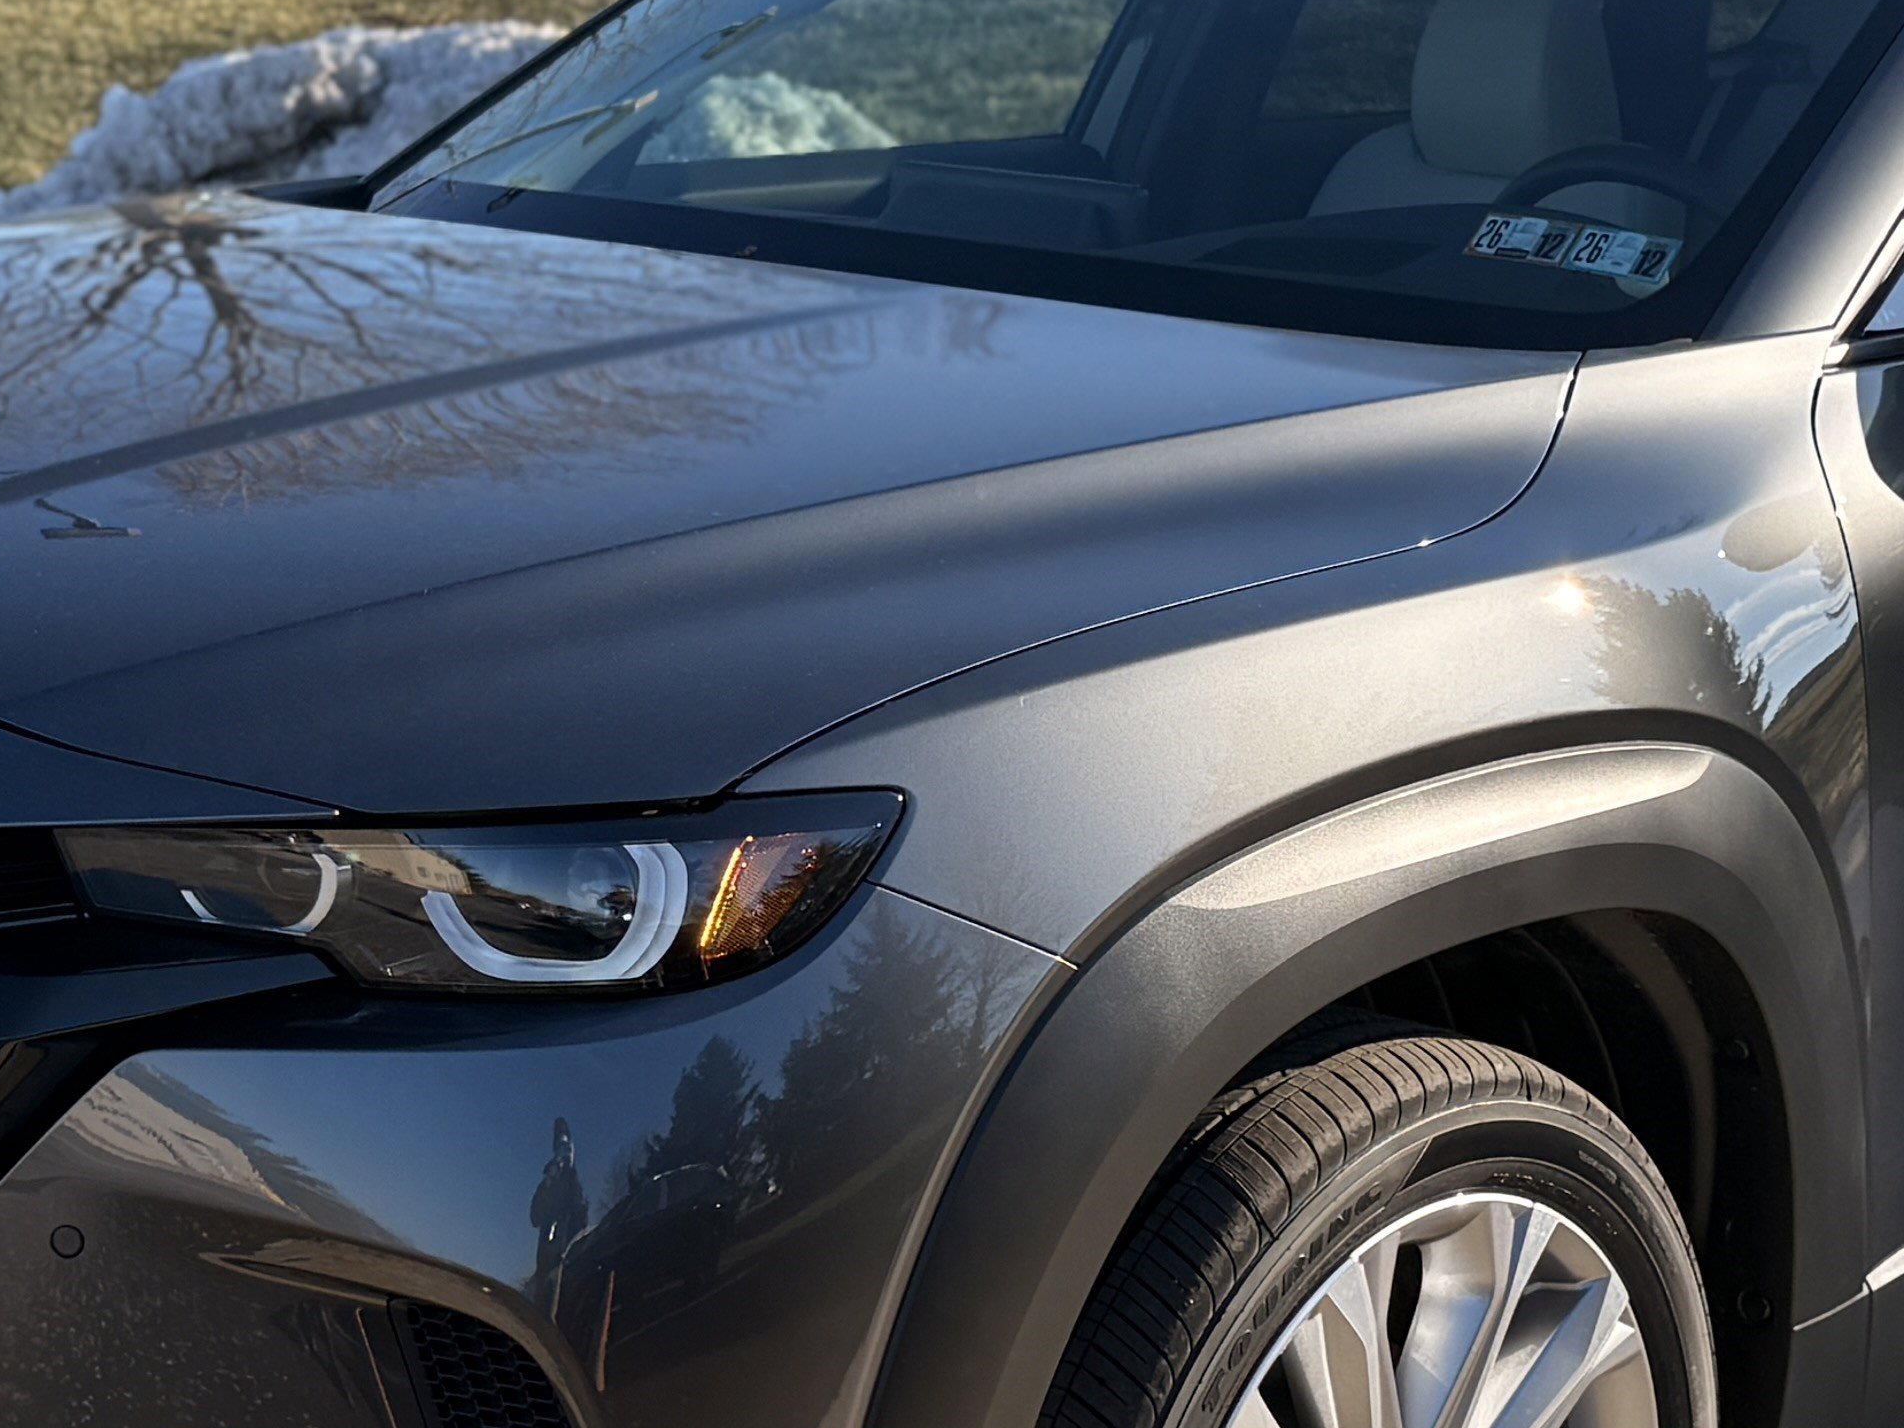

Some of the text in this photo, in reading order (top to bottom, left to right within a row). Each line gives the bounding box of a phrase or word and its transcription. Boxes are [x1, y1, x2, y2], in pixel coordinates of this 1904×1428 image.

[1475, 218, 1569, 260] 26 12
[1573, 231, 1667, 278] 26 12
[1201, 1182, 1382, 1413] TOURING
